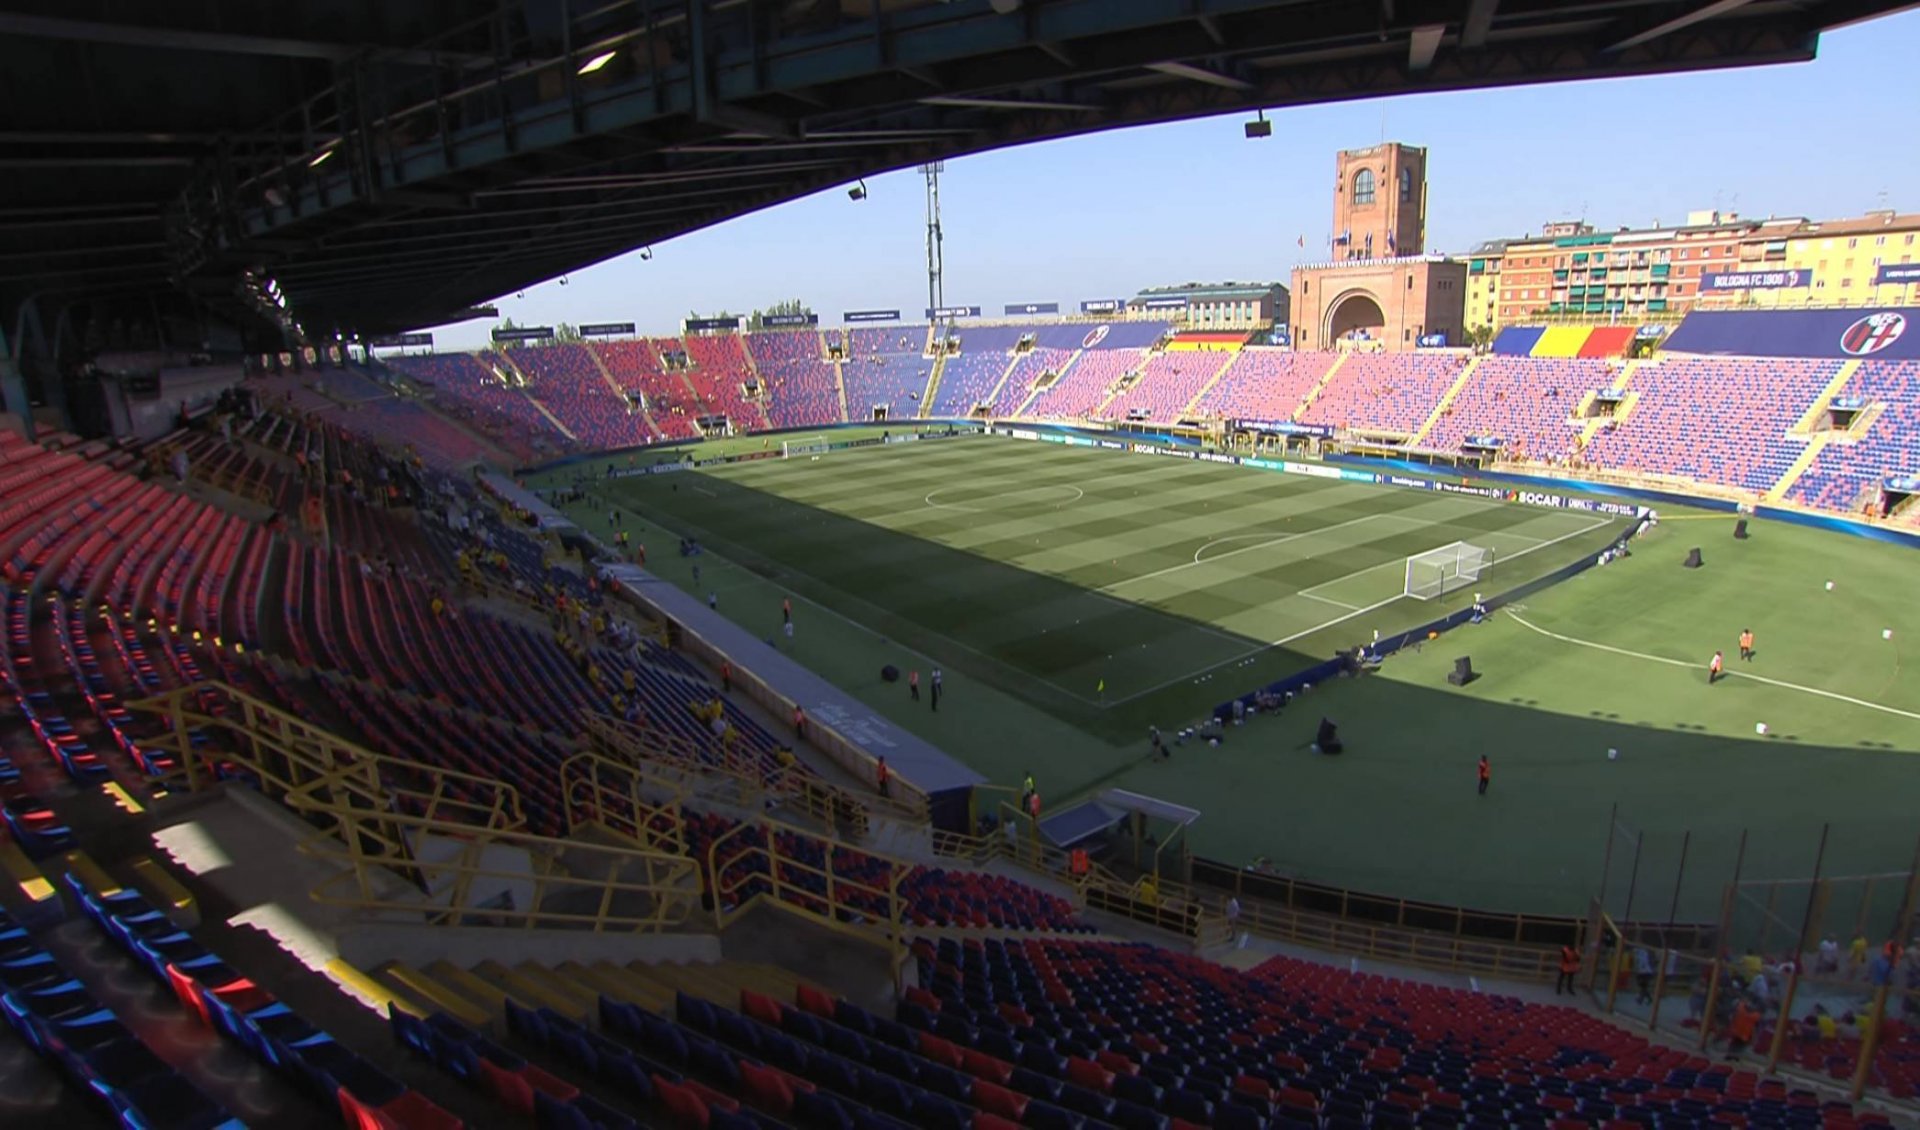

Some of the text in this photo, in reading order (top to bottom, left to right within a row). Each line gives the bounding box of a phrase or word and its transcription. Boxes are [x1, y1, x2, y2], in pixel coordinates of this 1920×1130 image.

[1714, 275, 1750, 287] BOLOGNA
[1751, 275, 1761, 286] FC
[1391, 476, 1426, 487] Booking.com
[1518, 491, 1561, 508] SOCAR
